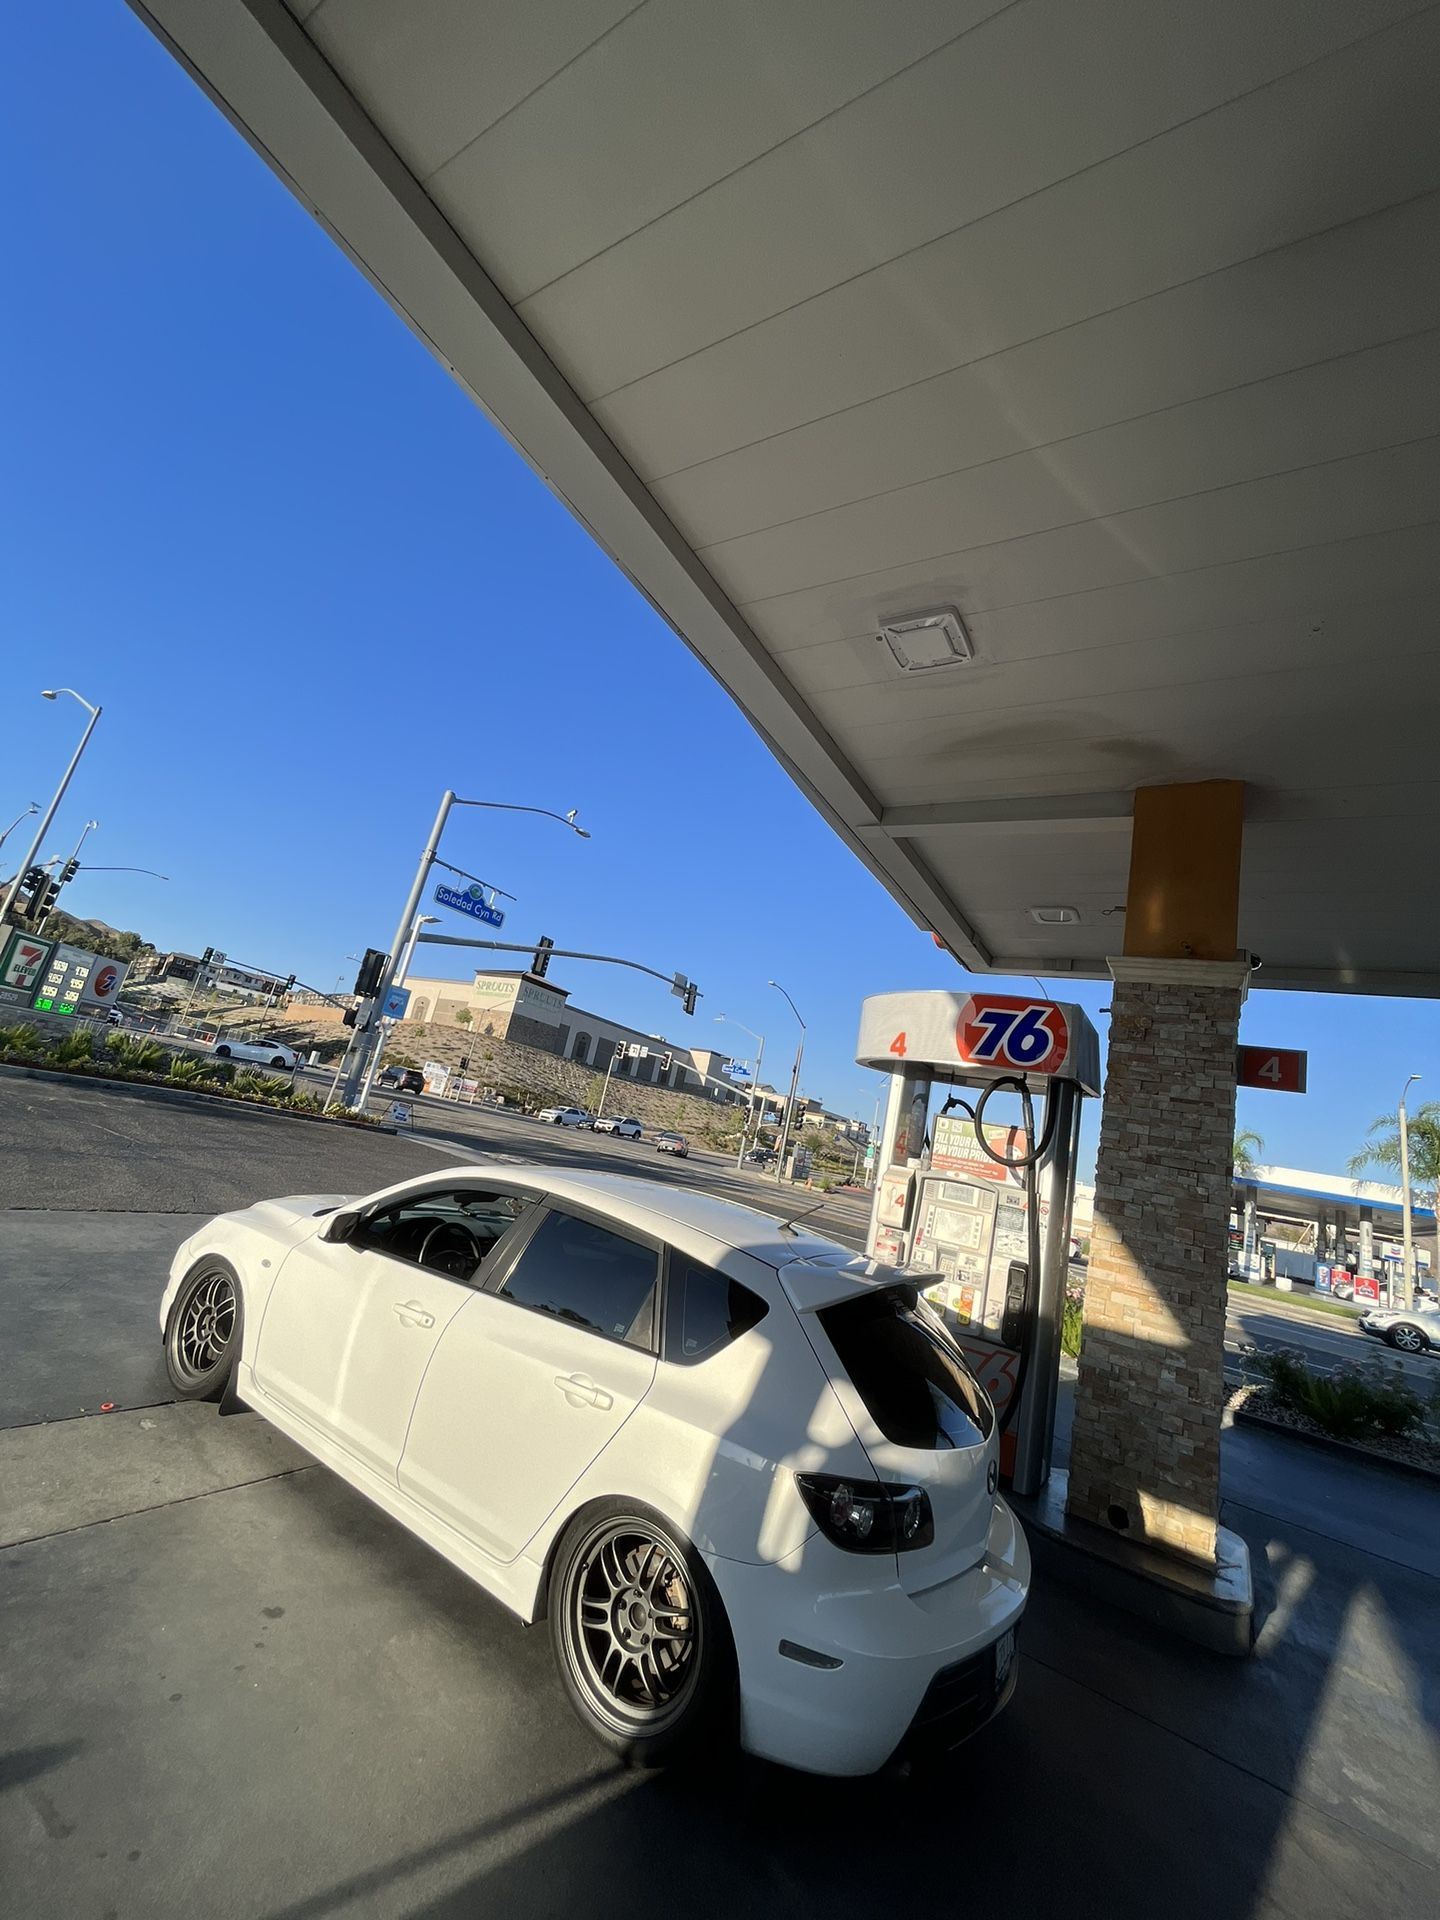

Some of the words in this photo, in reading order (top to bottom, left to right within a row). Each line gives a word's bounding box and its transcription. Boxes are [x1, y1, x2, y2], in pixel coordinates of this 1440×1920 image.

[438, 888, 473, 911] Soledad
[474, 904, 490, 919] Cyn
[492, 911, 502, 922] Rd
[20, 945, 44, 967] 7
[476, 981, 515, 993] SPROUTS
[524, 987, 563, 1009] SPROUTS
[889, 1031, 907, 1057] 4
[970, 1006, 1053, 1066] 76
[1257, 1056, 1282, 1083] 4
[935, 1130, 948, 1145] FILL
[949, 1133, 971, 1148] YOUR
[948, 1145, 970, 1159] YOUR
[894, 1193, 905, 1208] 4
